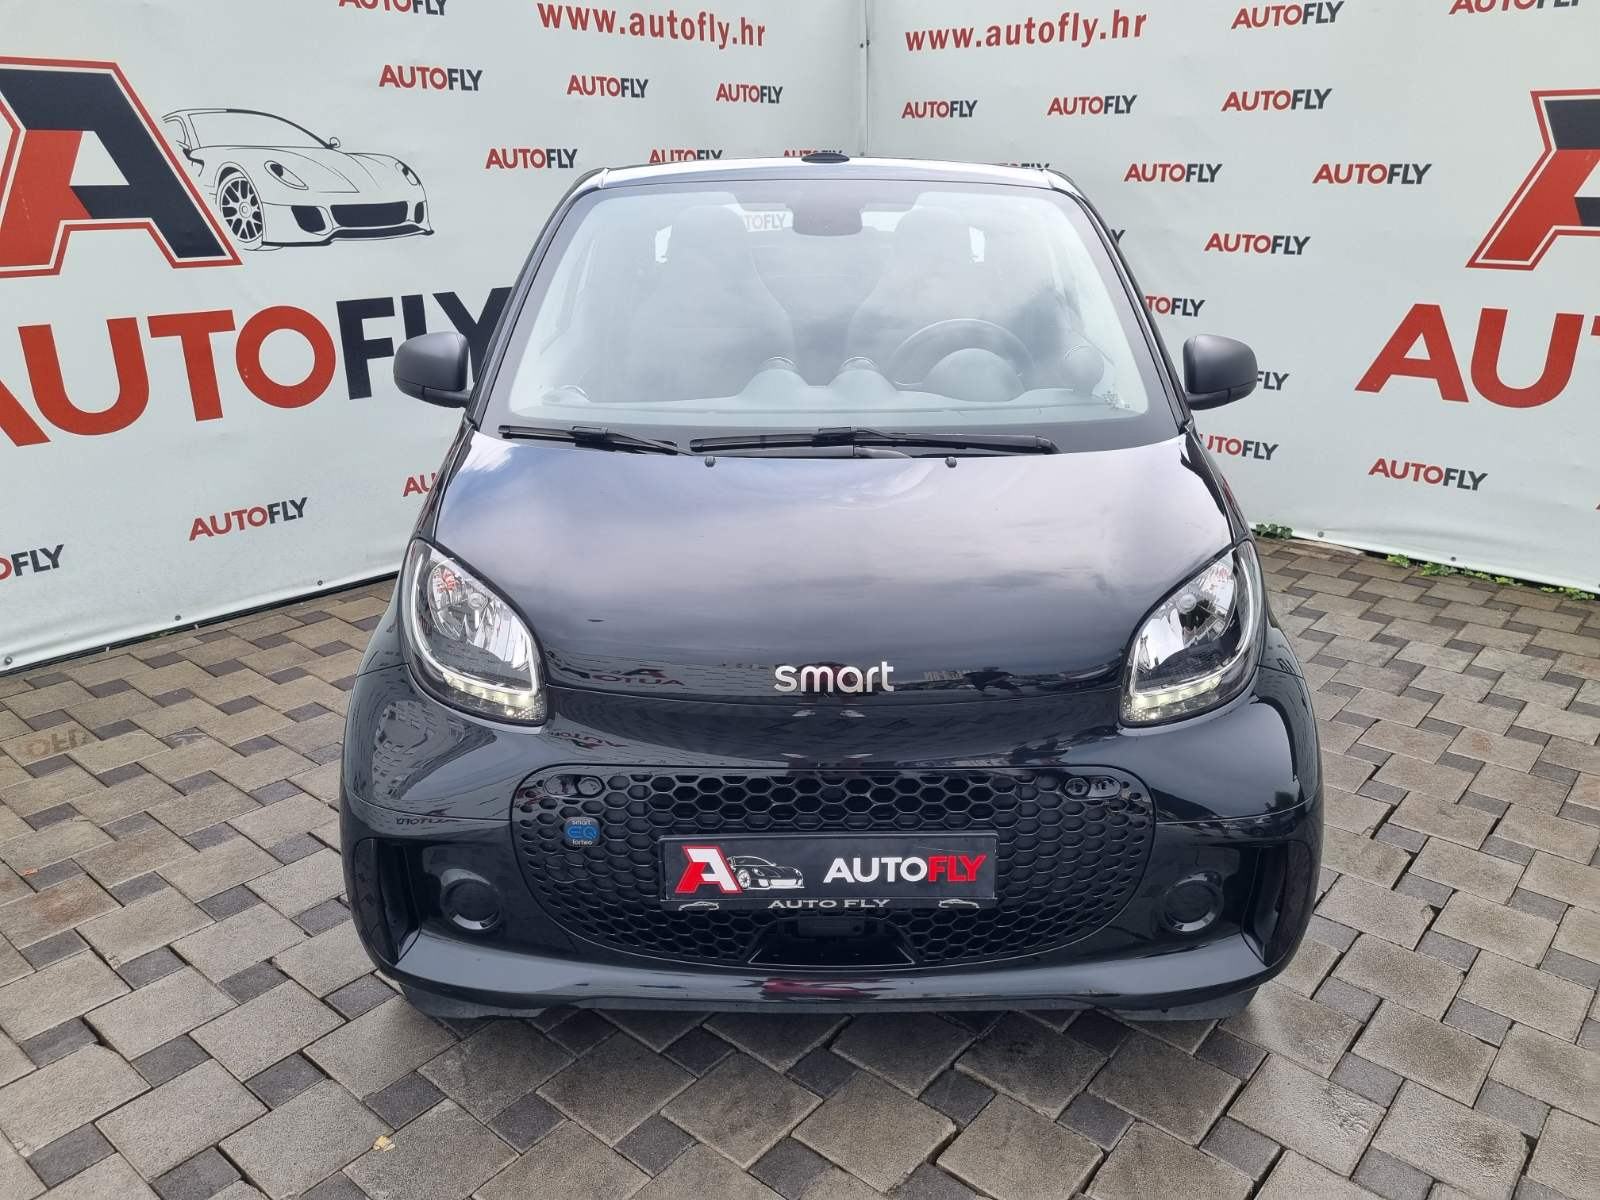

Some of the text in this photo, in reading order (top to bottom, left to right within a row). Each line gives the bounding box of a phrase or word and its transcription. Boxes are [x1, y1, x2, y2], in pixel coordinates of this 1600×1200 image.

[339, 0, 447, 16] OFLY
[1231, 1, 1345, 29] AUTOFLY
[537, 3, 765, 50] www.autofly.hr
[905, 9, 1147, 51] www.autofly.hr
[379, 64, 483, 91] AUTOFLY
[567, 75, 649, 99] AUTOFLY
[716, 82, 784, 104] AUTOFLY
[1047, 94, 1138, 116] AUTOFLY
[1222, 88, 1332, 112] AUTOFLY
[902, 100, 977, 119] AUTOFLY
[485, 148, 578, 169] AUTOFLY
[1124, 163, 1223, 183] AUTOFLY
[1312, 163, 1432, 184] AUTOFLY
[1204, 233, 1311, 255] AUTOFLY
[1354, 303, 1600, 409] AU
[1368, 458, 1488, 491] AUTOFLY
[189, 497, 308, 541] AUTOFLY
[774, 661, 895, 693] smart
[823, 854, 987, 883] AUTOFLY
[767, 899, 890, 909] AUTO FLY
